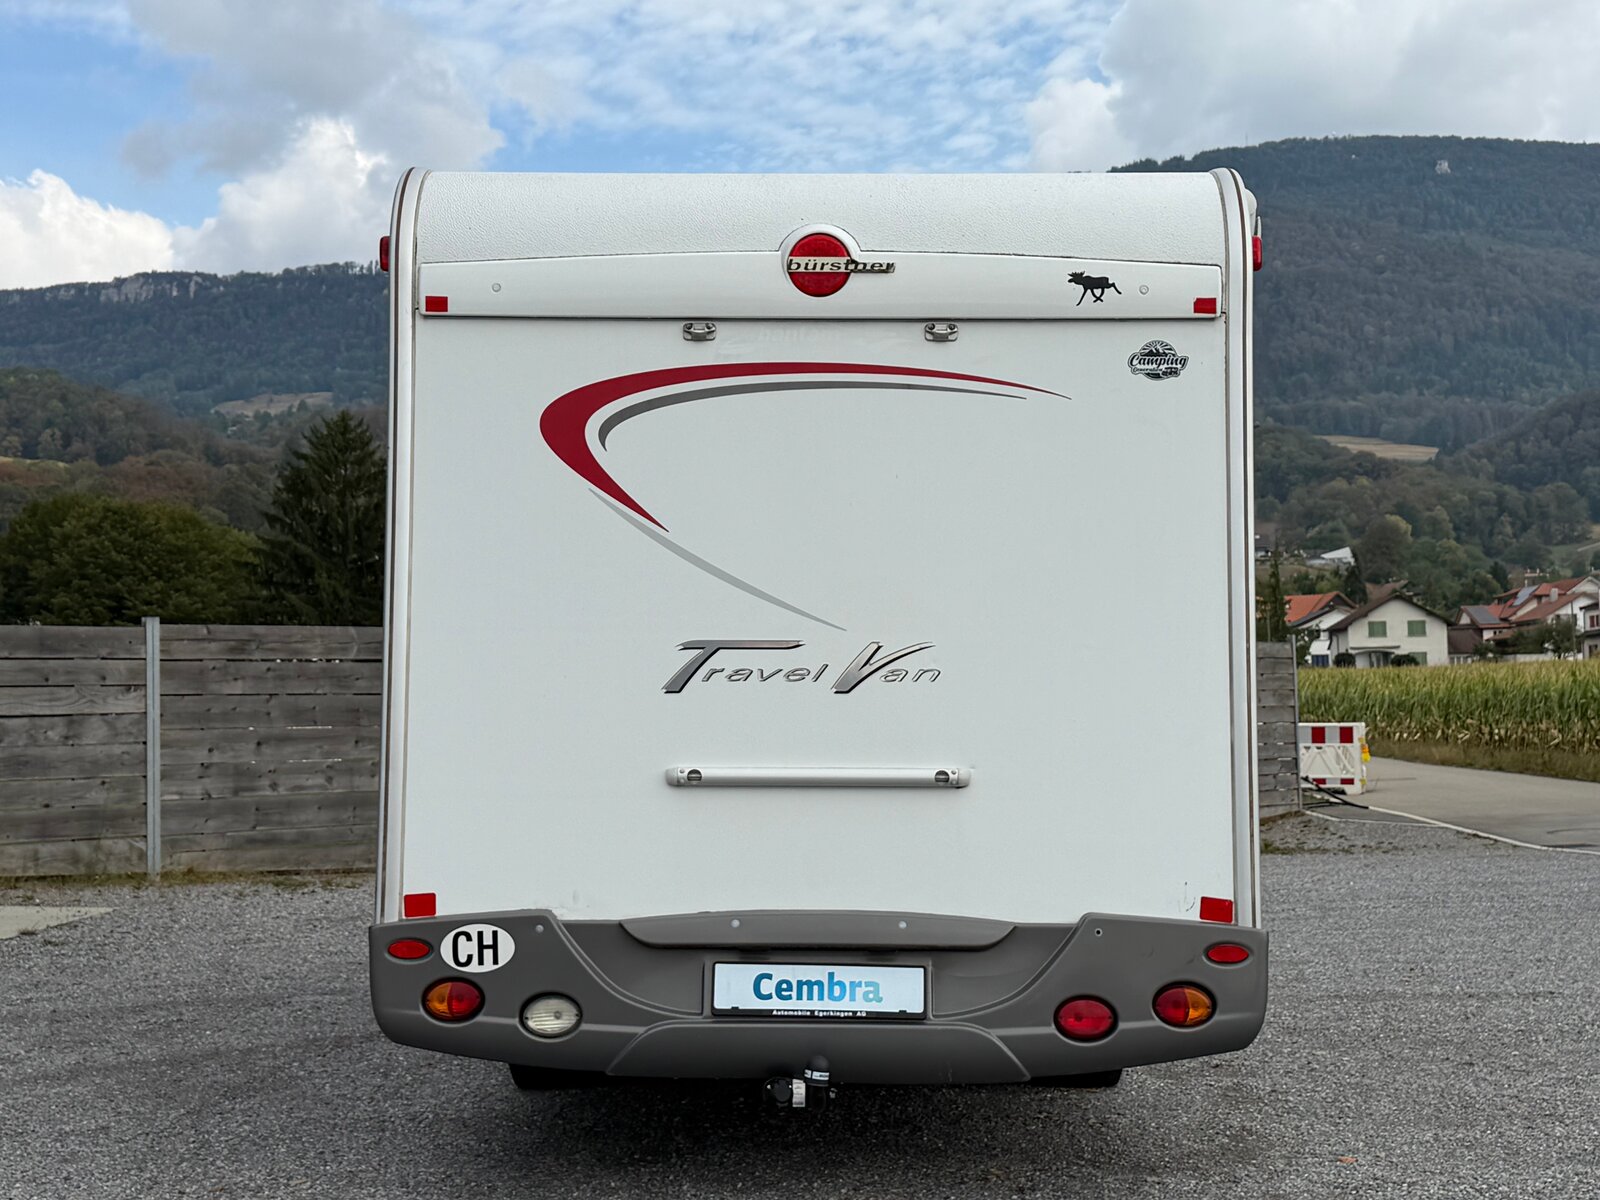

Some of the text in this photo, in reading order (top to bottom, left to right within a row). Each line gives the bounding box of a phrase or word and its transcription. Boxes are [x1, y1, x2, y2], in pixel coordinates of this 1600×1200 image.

[787, 258, 896, 273] bürstner
[1129, 354, 1187, 369] Camping
[661, 639, 942, 694] Travel Van
[452, 930, 499, 968] CH
[752, 971, 883, 1003] Cembra
